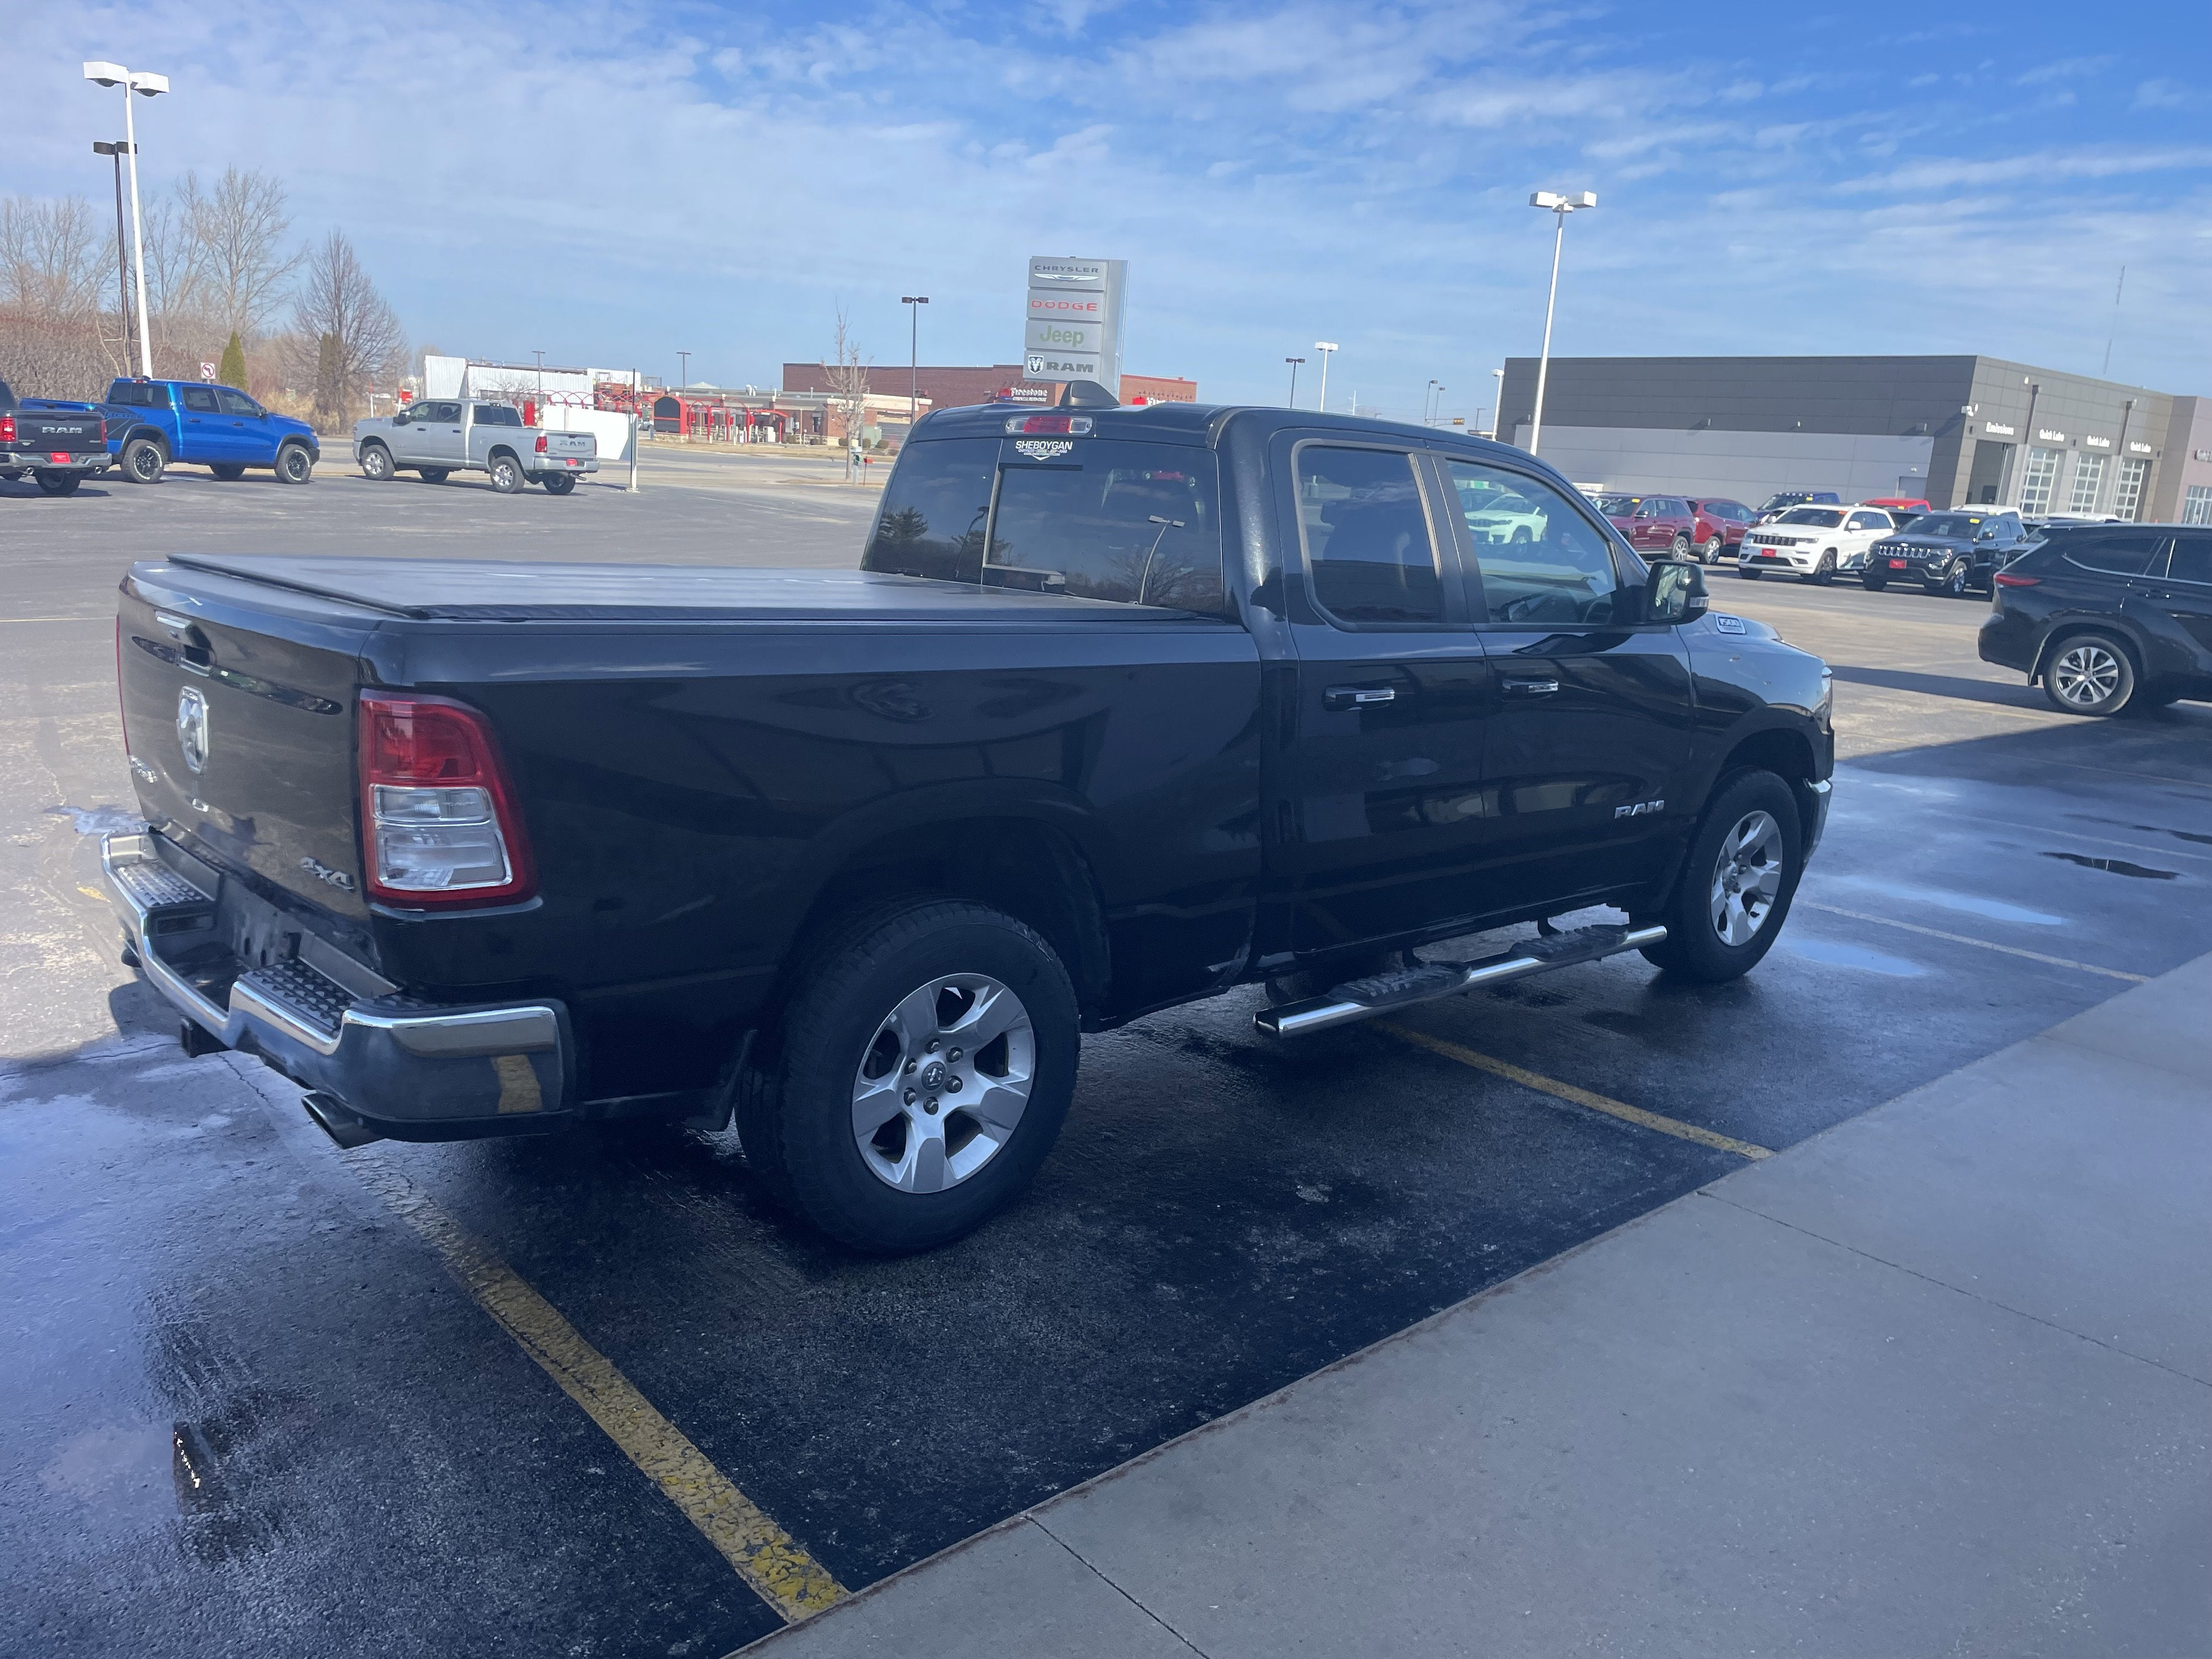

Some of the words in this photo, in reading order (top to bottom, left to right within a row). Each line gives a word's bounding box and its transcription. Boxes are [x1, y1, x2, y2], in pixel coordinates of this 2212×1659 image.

[1035, 265, 1099, 273] CHRYSLER
[1031, 300, 1098, 311] DODGE
[1040, 325, 1084, 347] Jeep
[1046, 362, 1093, 373] RAM
[1011, 387, 1047, 397] Firestone
[1985, 421, 2014, 436] Emissions
[1015, 441, 1073, 450] SHEBOYGAN
[1614, 800, 1664, 819] RAM
